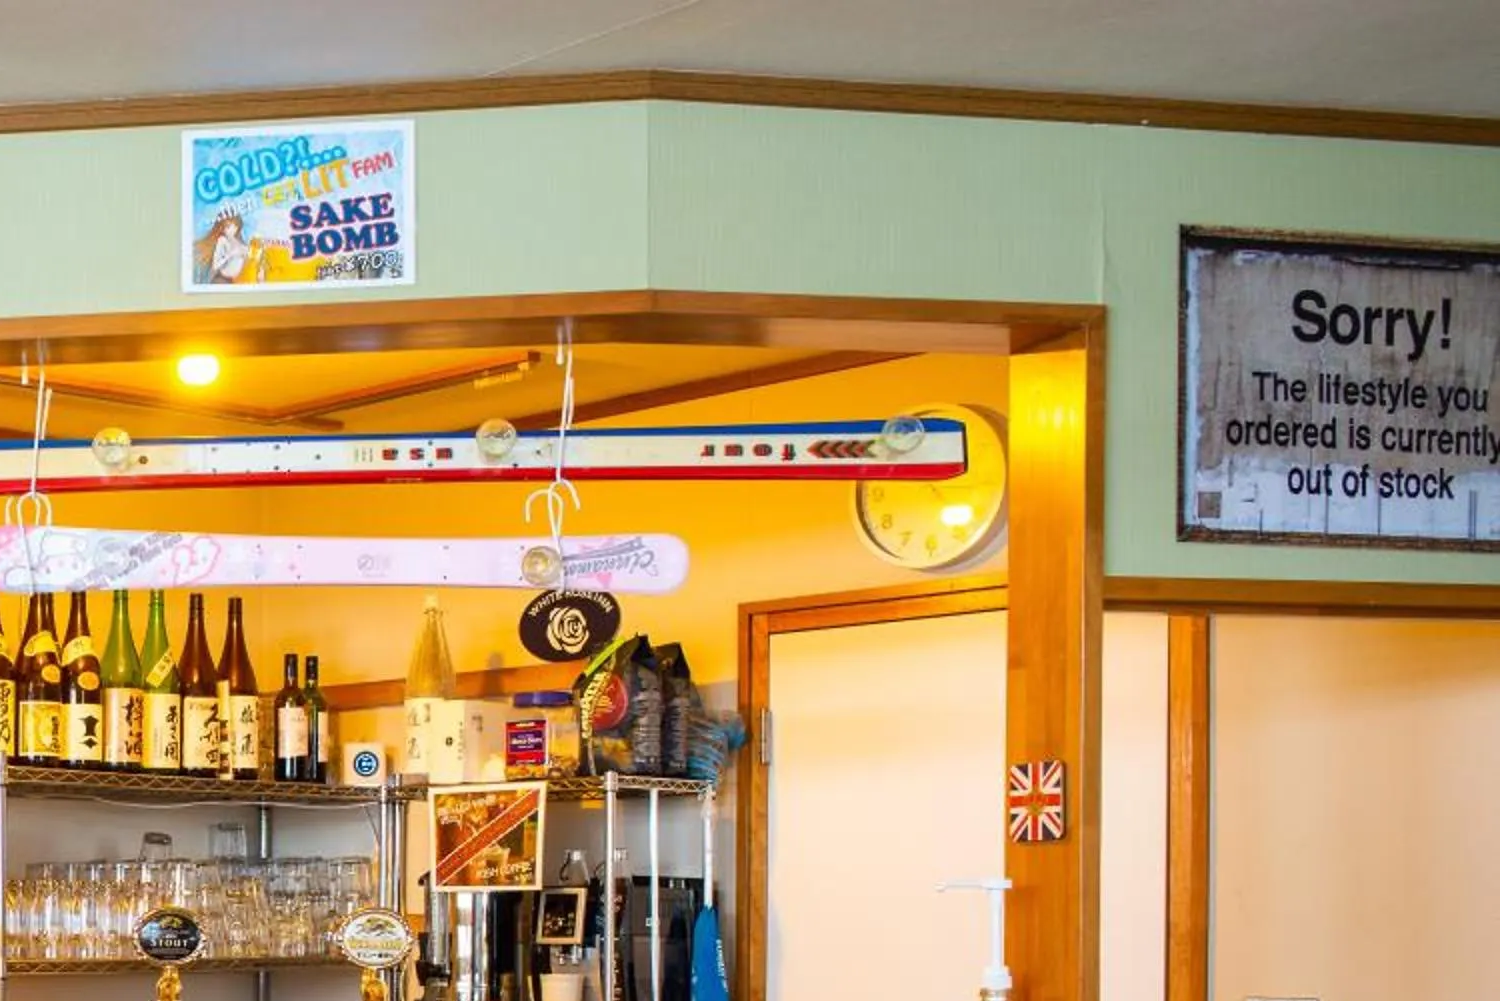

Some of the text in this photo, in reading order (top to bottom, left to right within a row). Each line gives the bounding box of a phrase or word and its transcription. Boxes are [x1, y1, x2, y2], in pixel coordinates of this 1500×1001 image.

[300, 159, 349, 199] LIT
[352, 152, 394, 179] FAM
[289, 193, 395, 231] SAKE
[291, 221, 399, 260] BOMB
[1291, 289, 1452, 362] Sorry!
[1251, 371, 1488, 417] The lifestyle you
[1226, 415, 1500, 465] ordered is currently
[1287, 464, 1455, 499] out of stock
